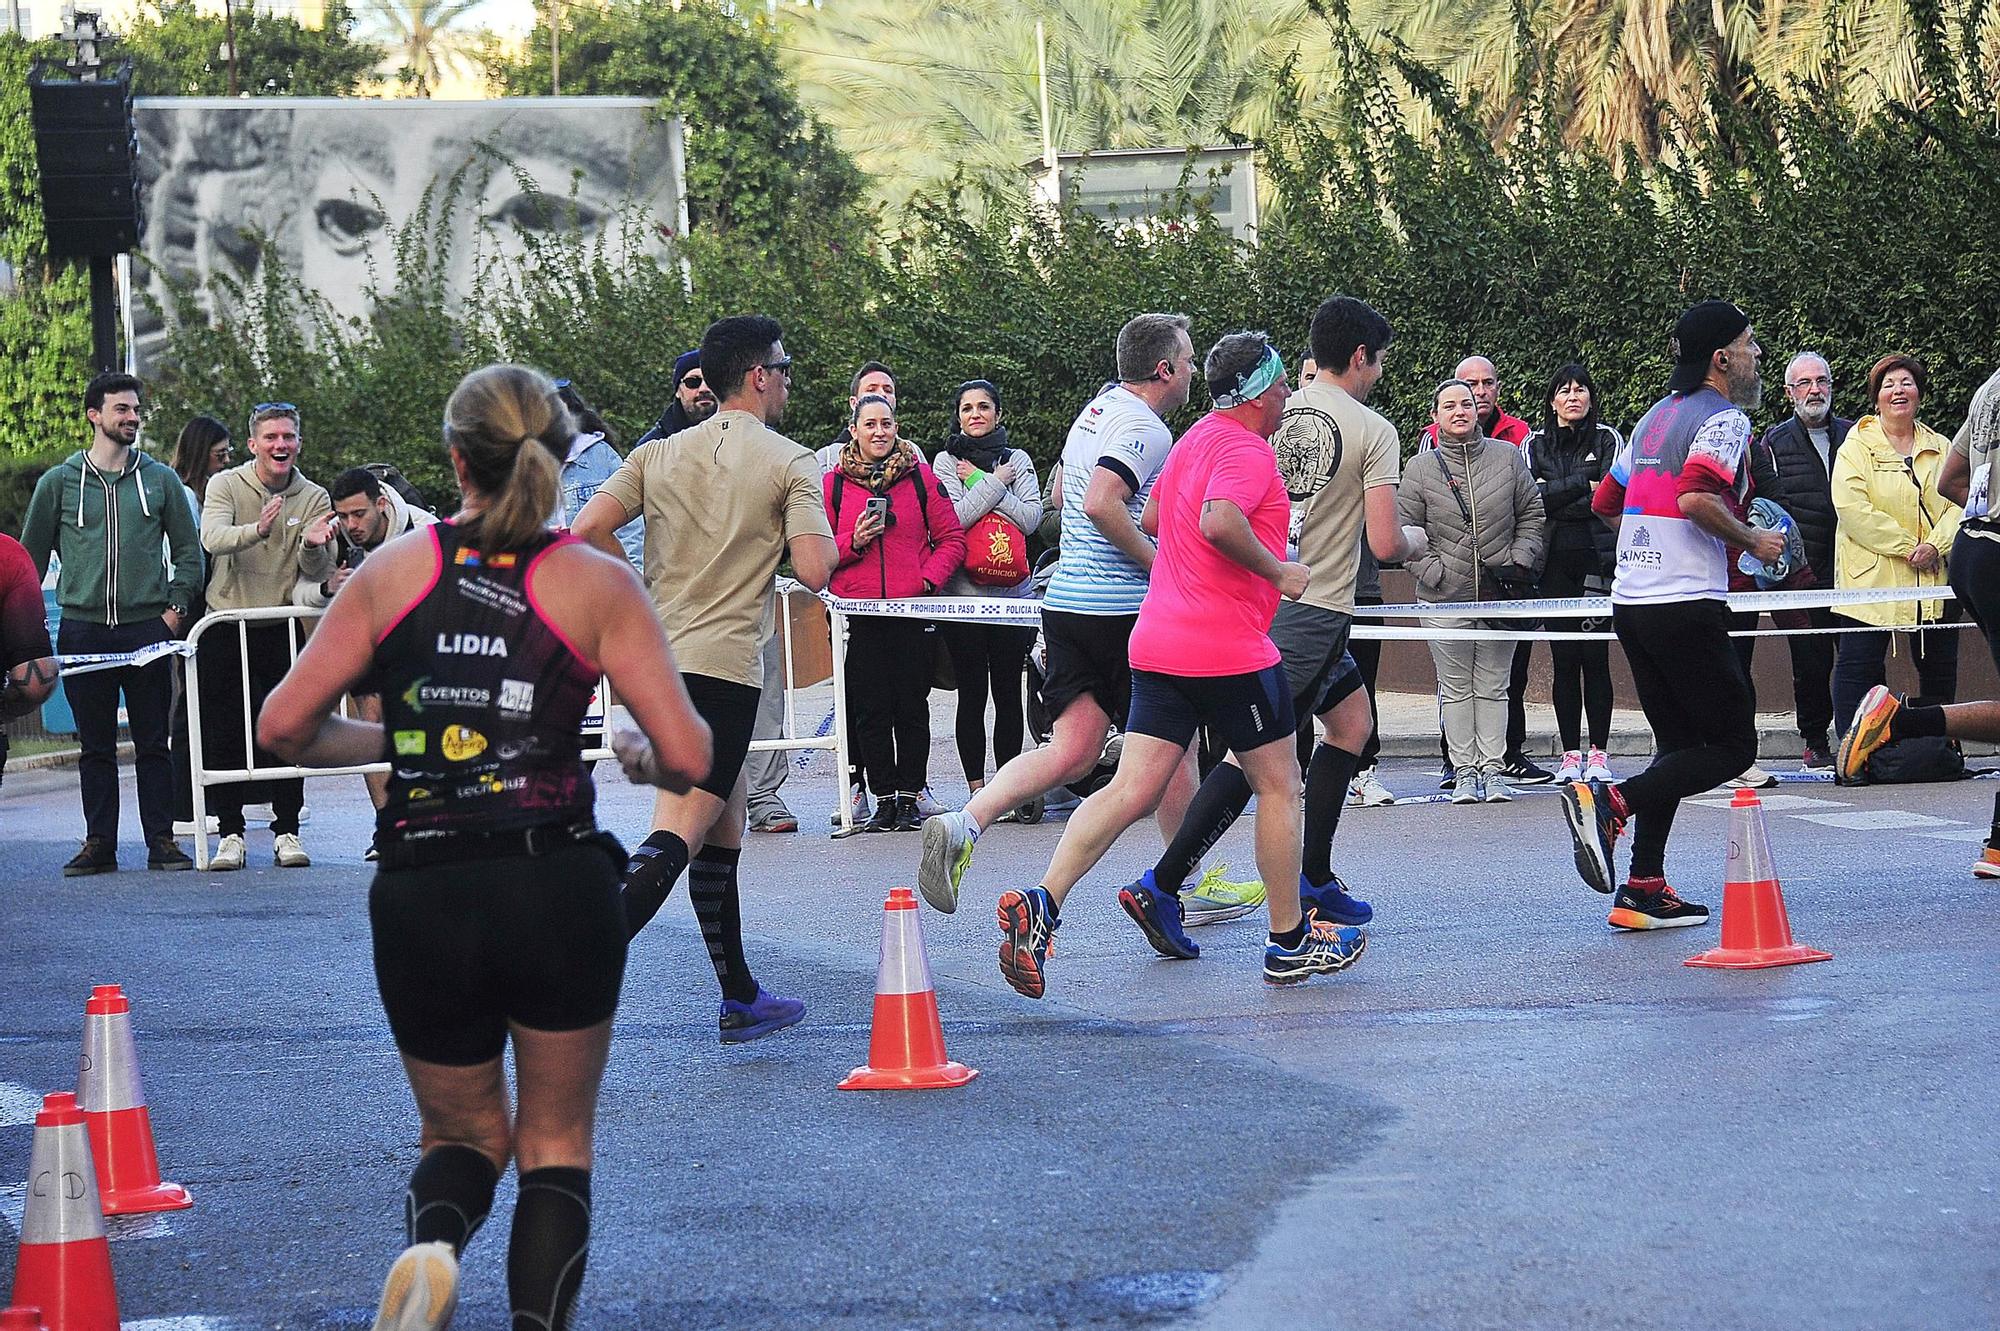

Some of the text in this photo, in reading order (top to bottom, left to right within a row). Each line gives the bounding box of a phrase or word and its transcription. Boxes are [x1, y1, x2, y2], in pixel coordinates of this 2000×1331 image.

[987, 568, 1018, 578] EDICIÓN
[832, 601, 858, 612] POLICIA
[859, 602, 881, 612] LOCAL
[910, 603, 946, 614] PROHIBIDO
[948, 604, 956, 614] EL
[957, 604, 975, 614] PASO
[1005, 605, 1032, 614] POLICIA
[437, 633, 508, 658] LIDIA
[420, 686, 490, 702] EVENTOS
[1187, 807, 1235, 869] kalenji
